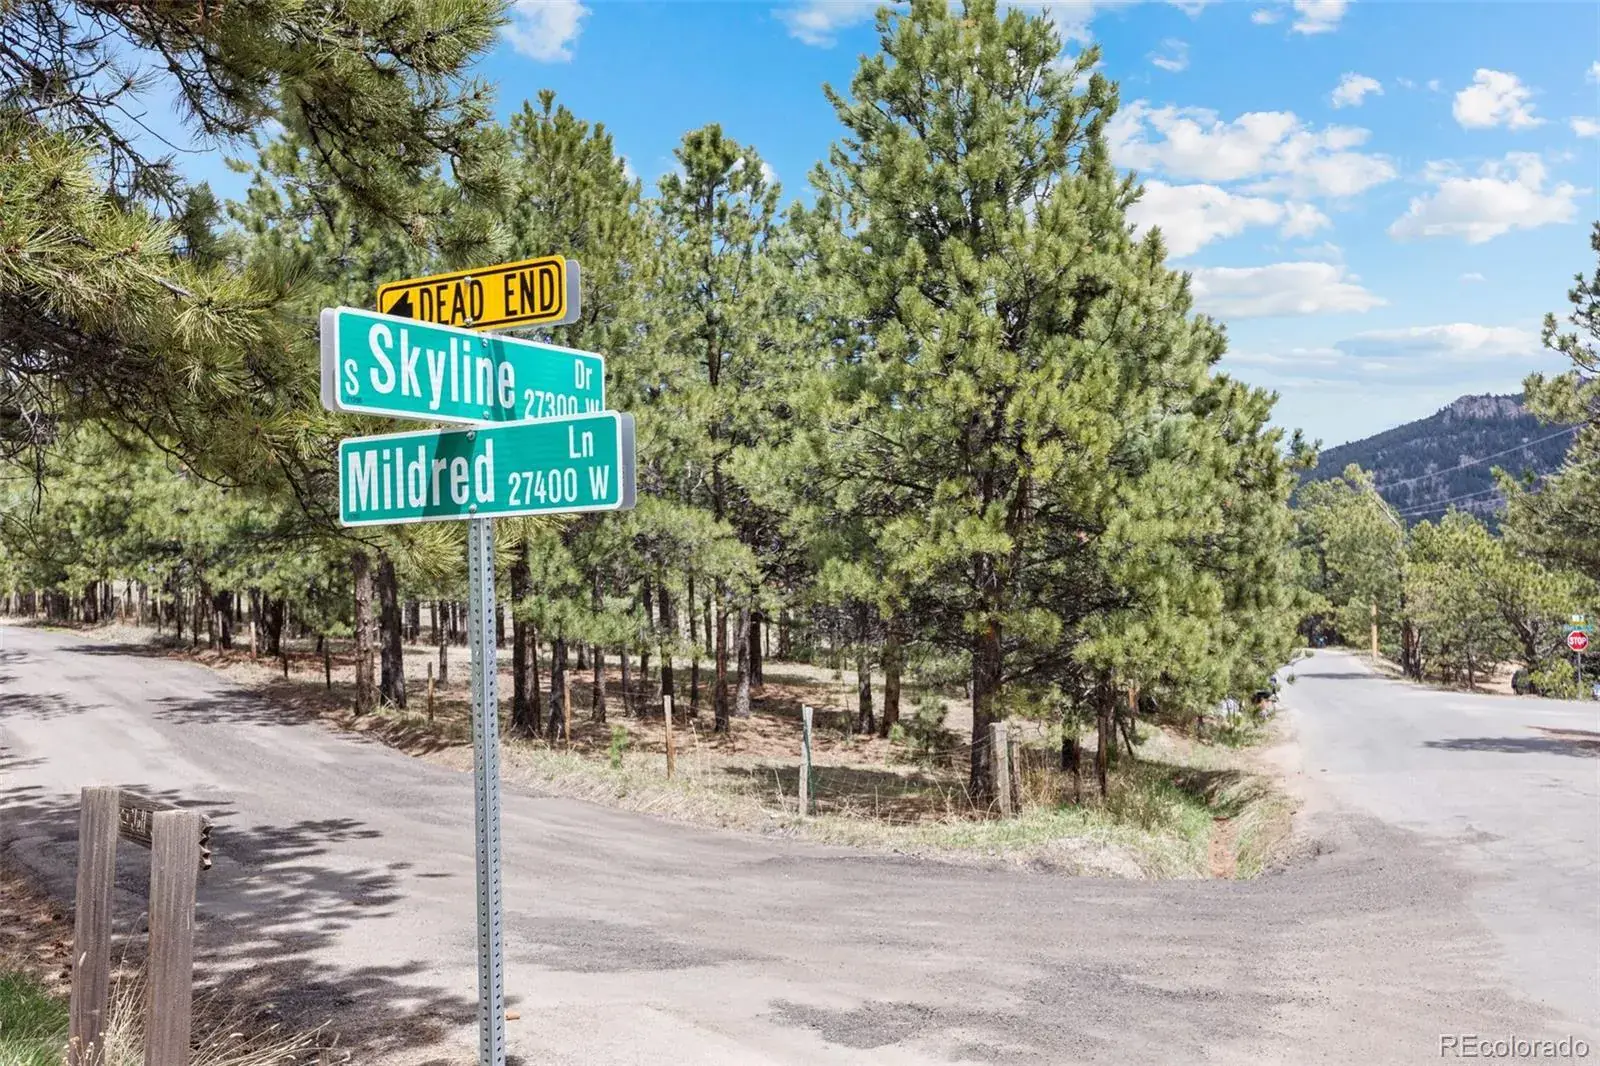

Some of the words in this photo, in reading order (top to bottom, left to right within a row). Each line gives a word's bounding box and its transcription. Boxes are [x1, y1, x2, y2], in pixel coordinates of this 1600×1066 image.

[419, 279, 484, 325] DEAD
[504, 267, 554, 317] END
[345, 358, 360, 396] S
[368, 323, 516, 411] Skyline
[574, 358, 593, 390] Dr
[524, 388, 578, 419] 27300
[348, 438, 495, 512] Mildred
[568, 425, 594, 459] Ln
[508, 468, 578, 506] 27400
[589, 465, 610, 500] W
[1569, 636, 1587, 646] STOP
